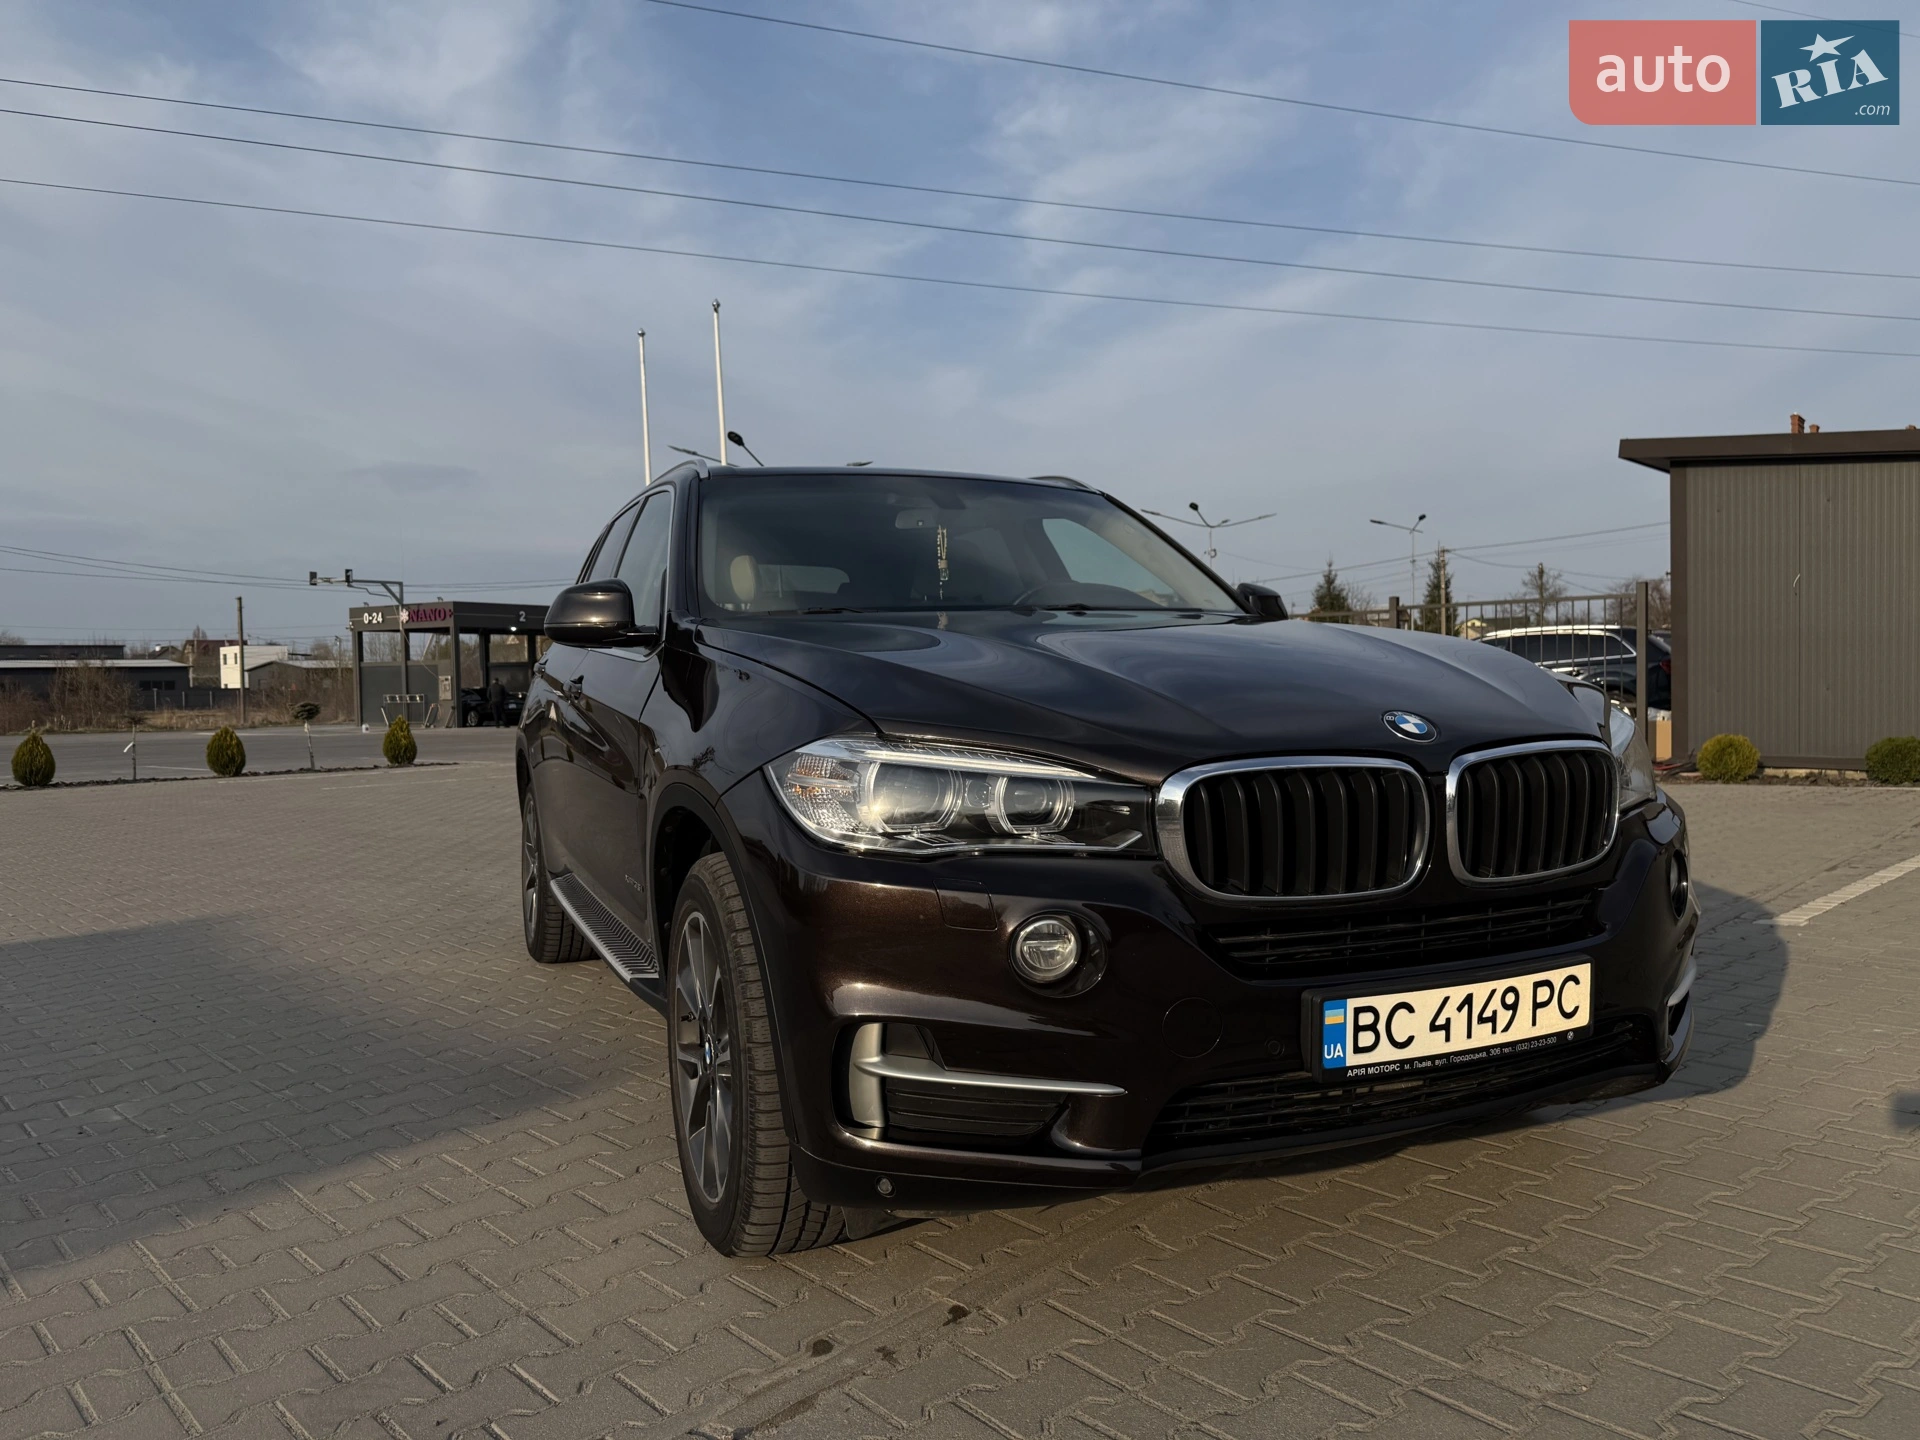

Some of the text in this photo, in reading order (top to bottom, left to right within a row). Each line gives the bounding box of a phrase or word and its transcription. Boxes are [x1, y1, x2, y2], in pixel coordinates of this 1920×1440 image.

[363, 611, 383, 624] 0-24
[409, 607, 447, 623] NANO
[519, 611, 526, 622] 2
[1353, 974, 1581, 1054] BC 4149 PC
[1324, 1043, 1344, 1059] UA
[1347, 1067, 1366, 1077] АРІЯ
[1367, 1064, 1401, 1075] МОТОРС
[1515, 1042, 1530, 1052] (032)
[1530, 1036, 1557, 1048] 23-23-500
